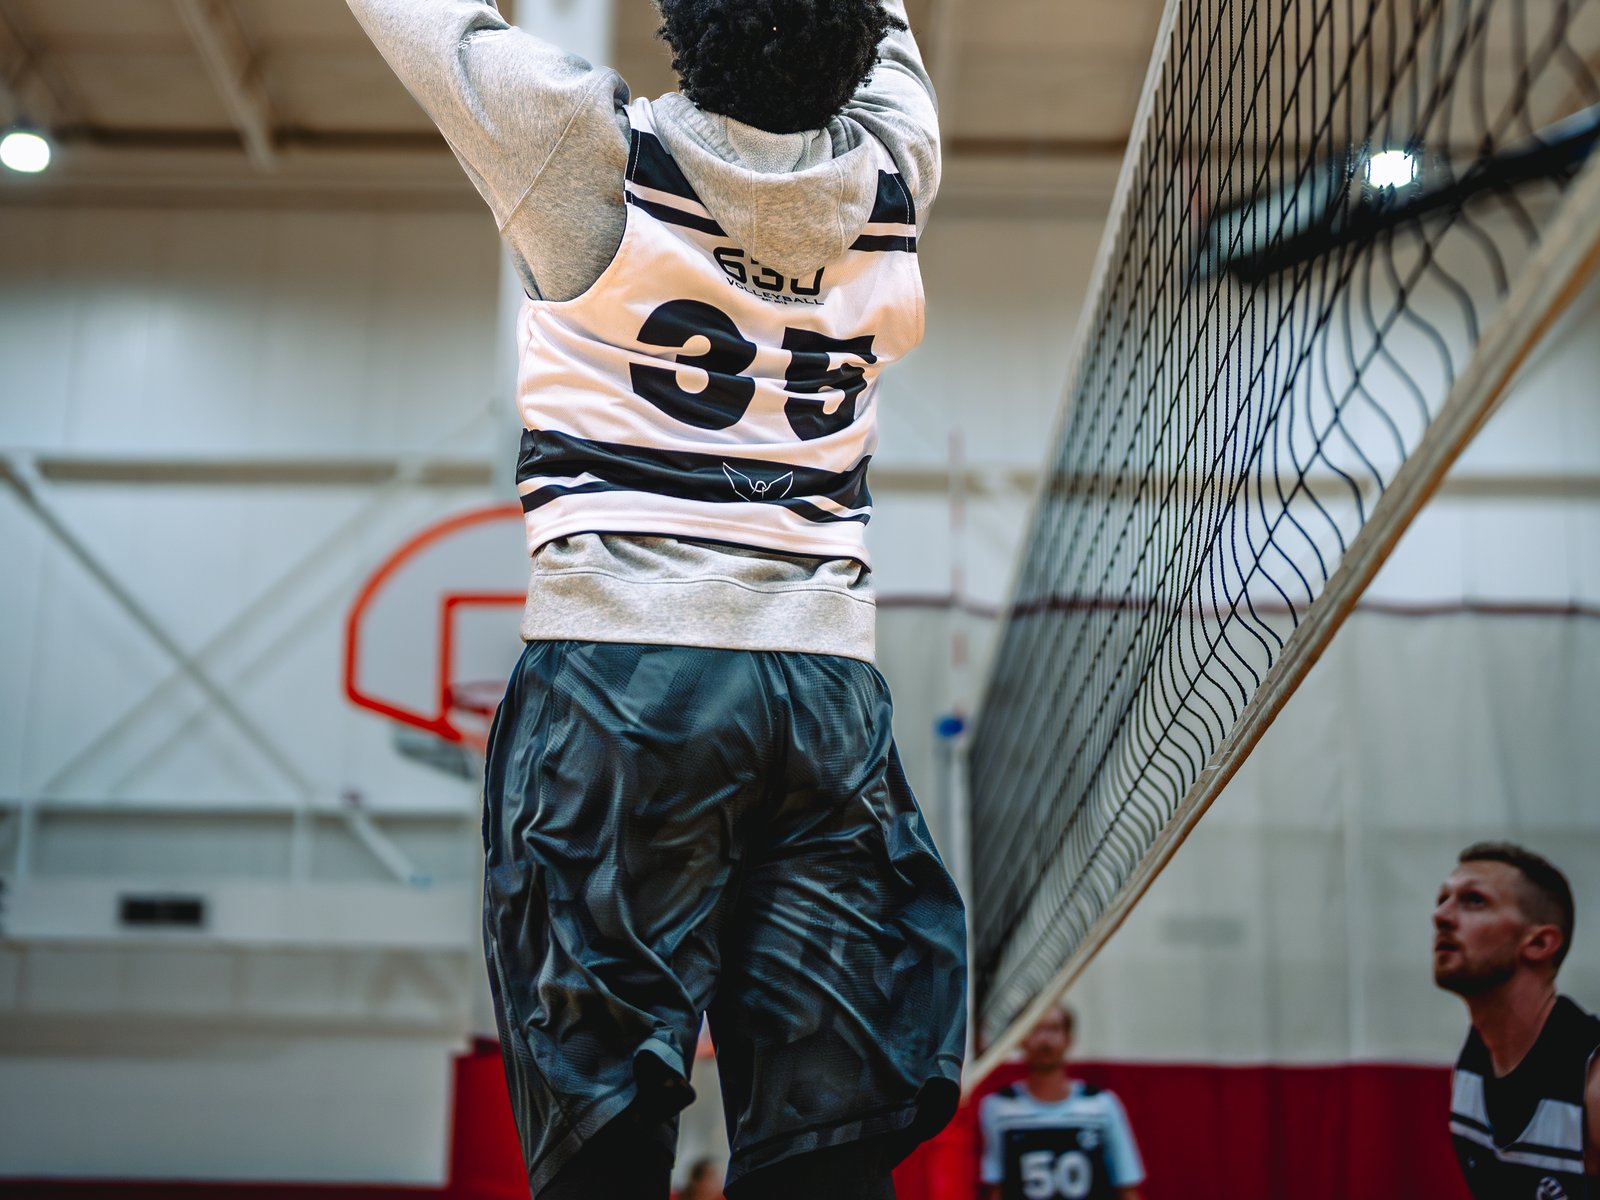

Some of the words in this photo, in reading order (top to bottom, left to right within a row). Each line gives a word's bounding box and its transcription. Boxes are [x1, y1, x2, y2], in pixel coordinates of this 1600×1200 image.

[726, 277, 824, 305] VOLLEYBALL
[629, 299, 877, 442] 35
[1020, 1150, 1092, 1200] 50
